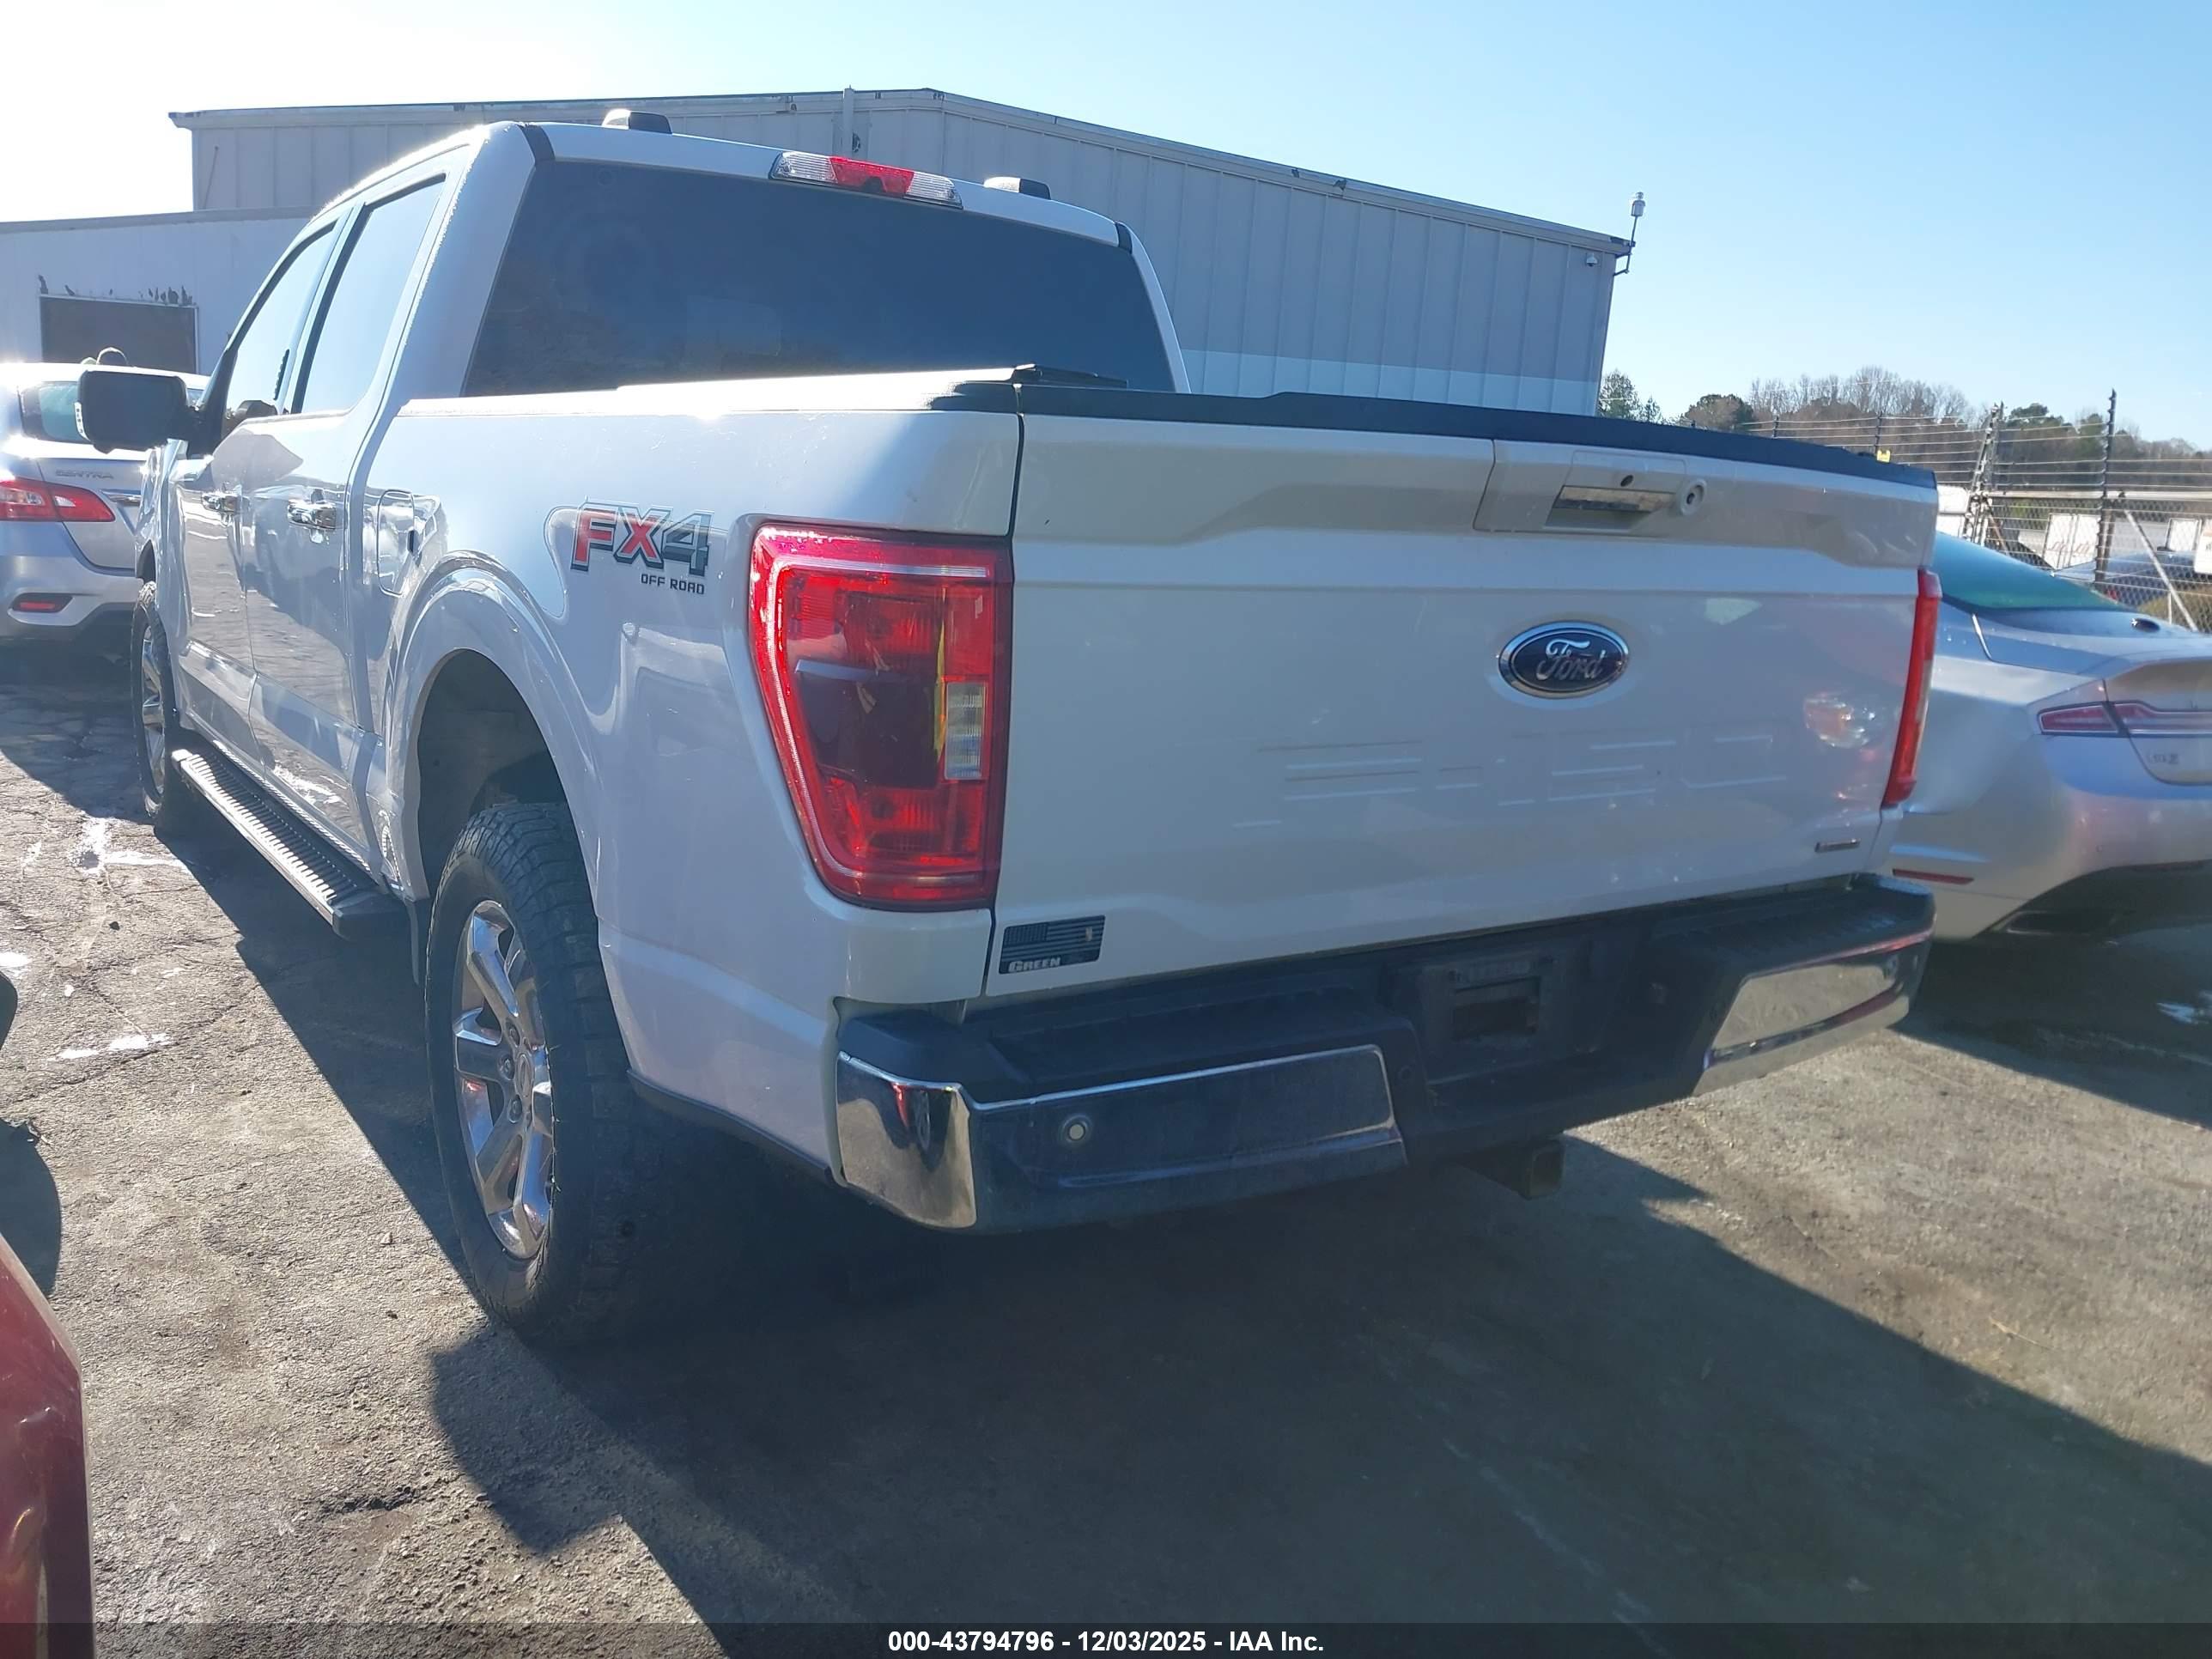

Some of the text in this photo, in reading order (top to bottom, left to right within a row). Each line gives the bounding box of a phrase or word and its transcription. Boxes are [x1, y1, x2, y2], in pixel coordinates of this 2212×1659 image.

[570, 501, 715, 577] FX4
[641, 574, 705, 595] OFF ROAD
[1535, 639, 1607, 680] Ford
